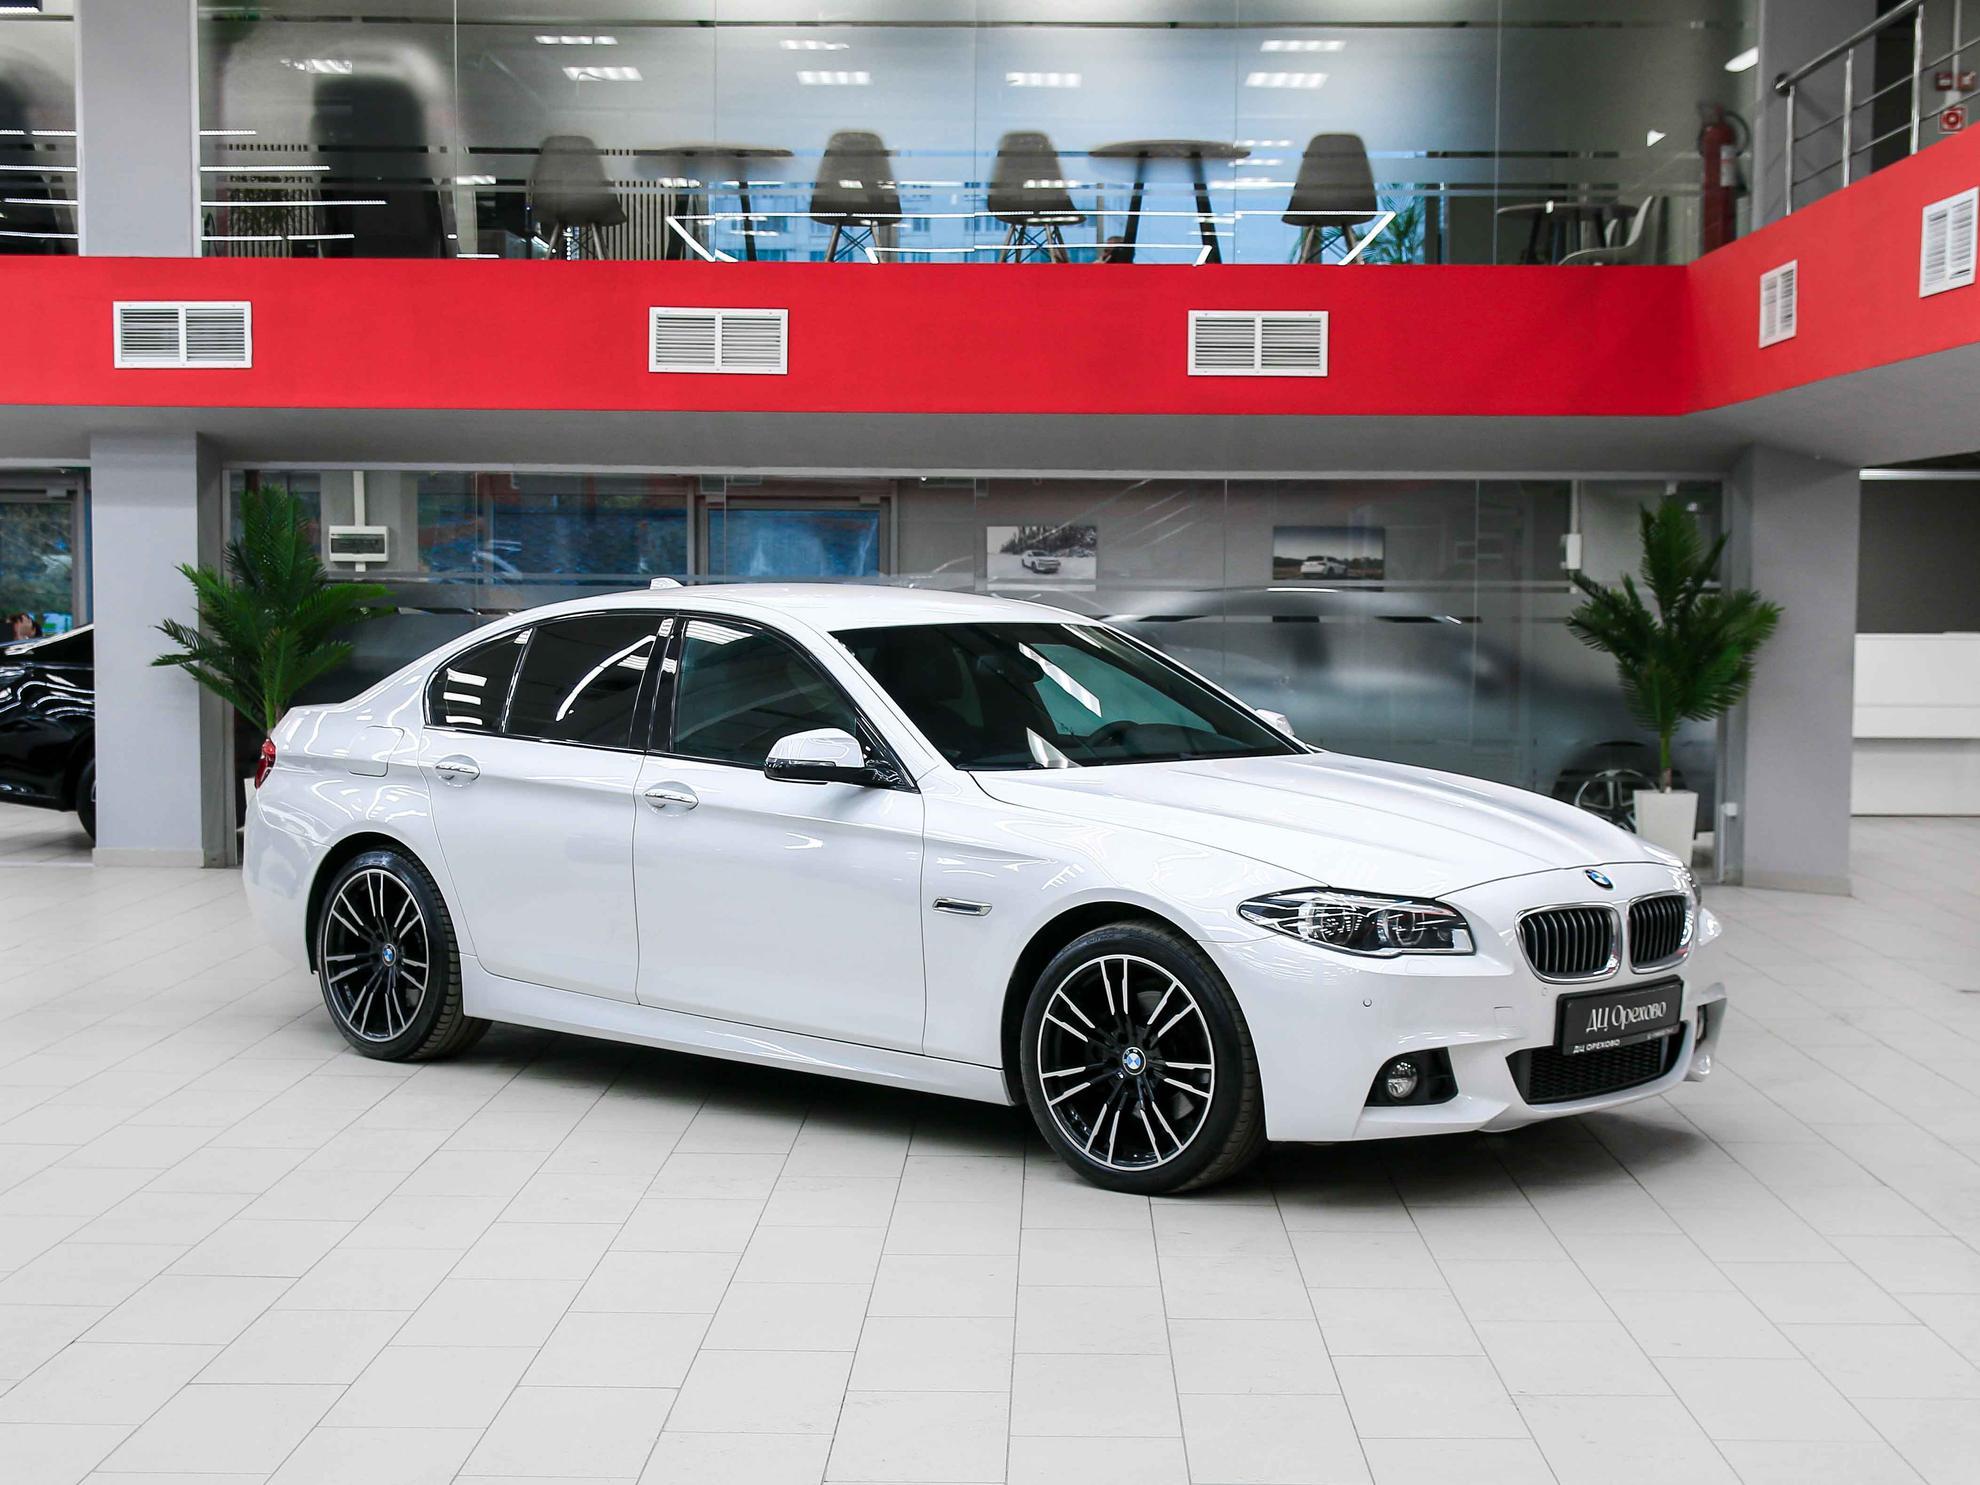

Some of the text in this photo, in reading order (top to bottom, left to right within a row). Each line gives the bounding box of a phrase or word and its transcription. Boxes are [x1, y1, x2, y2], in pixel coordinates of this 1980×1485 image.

[1585, 1001, 1667, 1033] ДЦ Орехово
[1586, 1039, 1620, 1051] ОРЕХОВО
